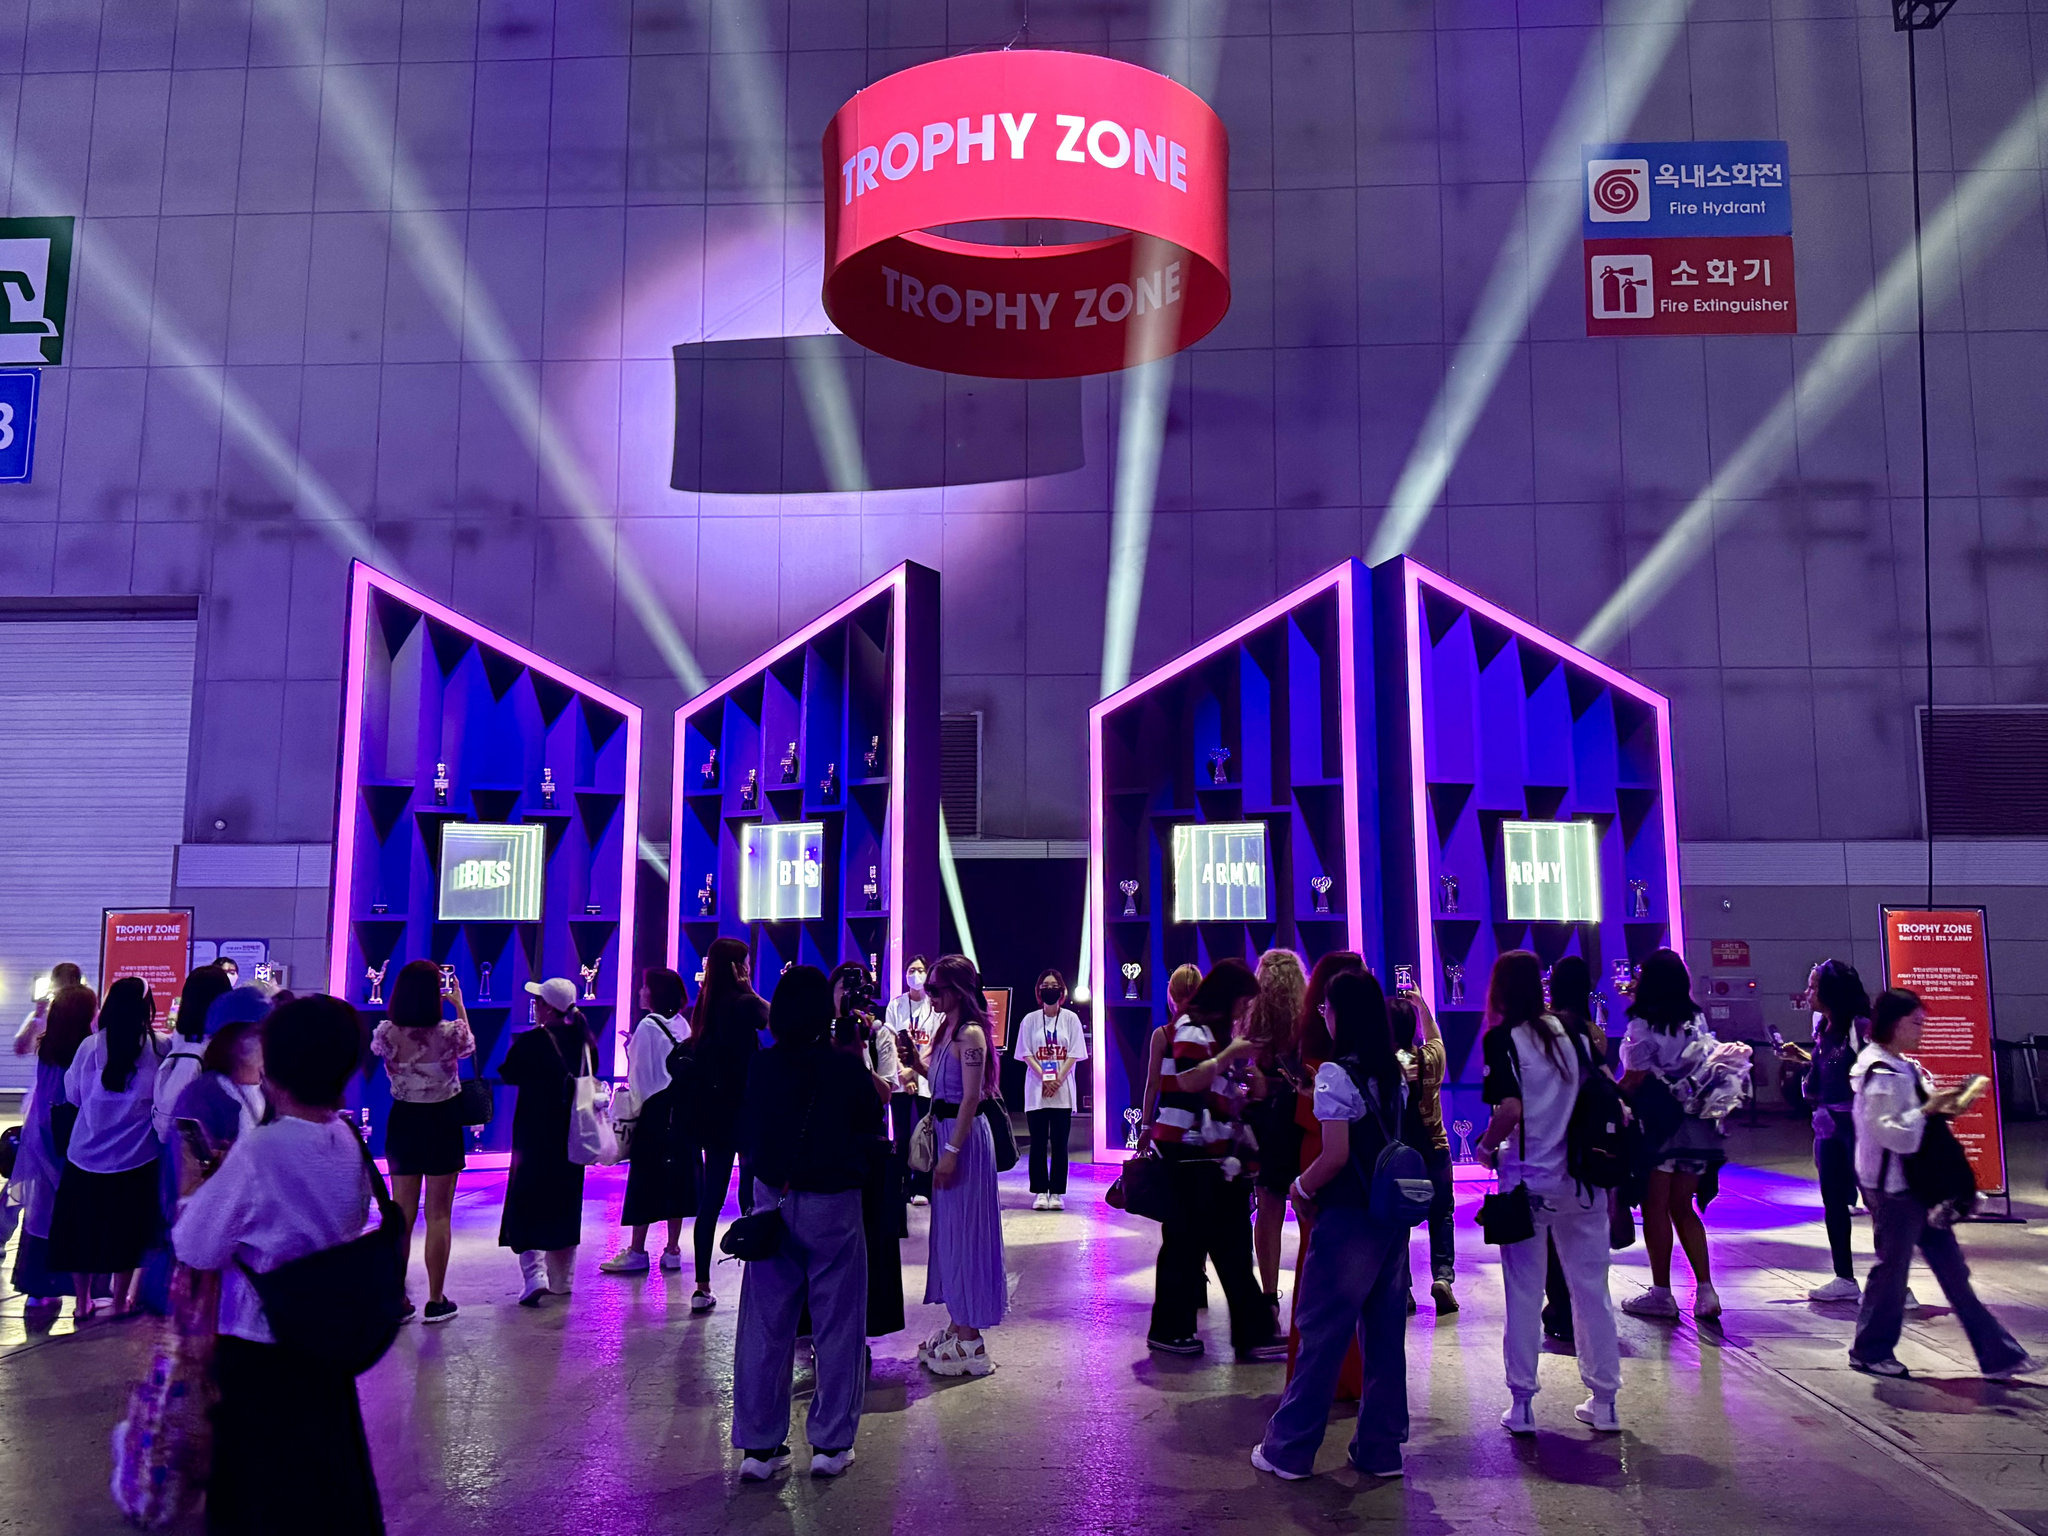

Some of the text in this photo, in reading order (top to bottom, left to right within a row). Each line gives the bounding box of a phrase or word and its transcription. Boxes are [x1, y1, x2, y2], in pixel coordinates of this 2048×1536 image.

[842, 112, 1188, 206] TROPHY ZONE
[1654, 163, 1783, 189] 옥내소화전
[1669, 200, 1766, 217] Fire Hydrant
[880, 261, 1181, 331] TROPHY ZONE
[1660, 298, 1789, 314] Fire Extinguisher
[465, 860, 511, 886] BTS
[779, 859, 816, 886] BTS
[1201, 861, 1257, 885] ARMY
[1508, 861, 1561, 884] ARMY
[115, 924, 181, 934] TROPHY ZONE
[1896, 923, 1973, 934] TROPHY ZONE
